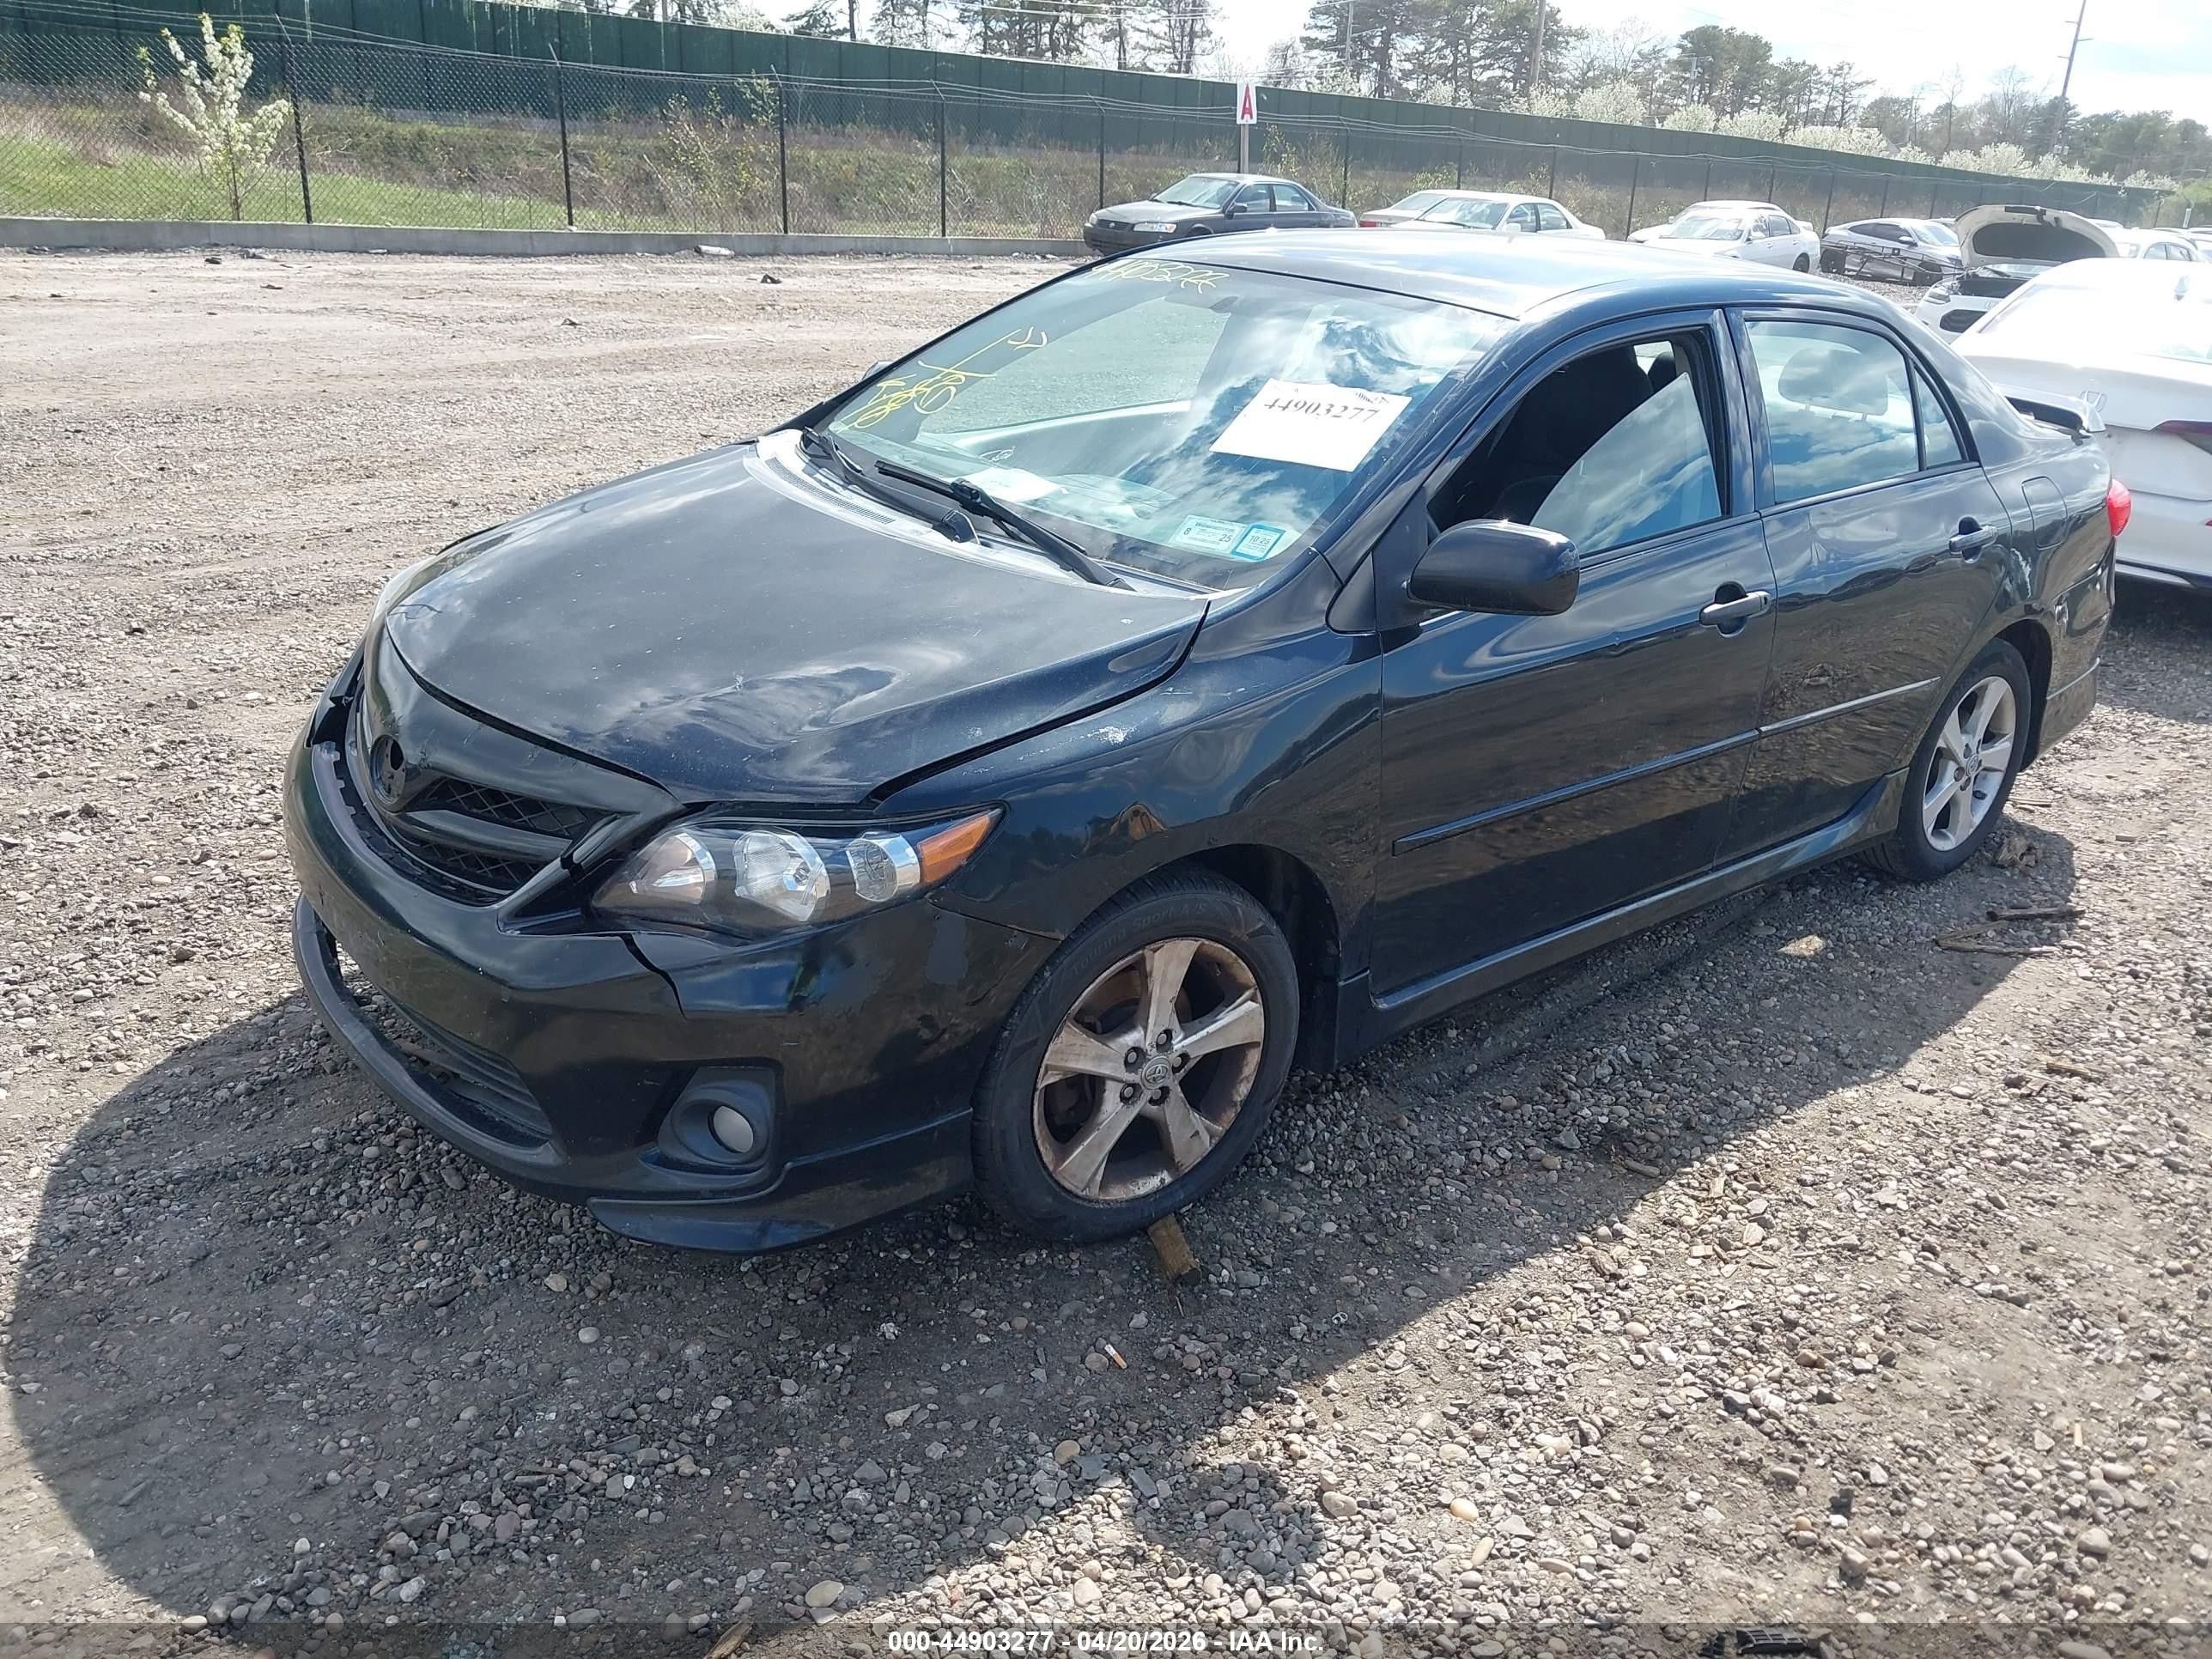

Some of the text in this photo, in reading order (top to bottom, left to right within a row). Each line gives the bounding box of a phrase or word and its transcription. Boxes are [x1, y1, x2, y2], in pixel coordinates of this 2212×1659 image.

[1241, 83, 1254, 120] A
[1264, 398, 1381, 422] 44903277
[1218, 533, 1233, 543] 25
